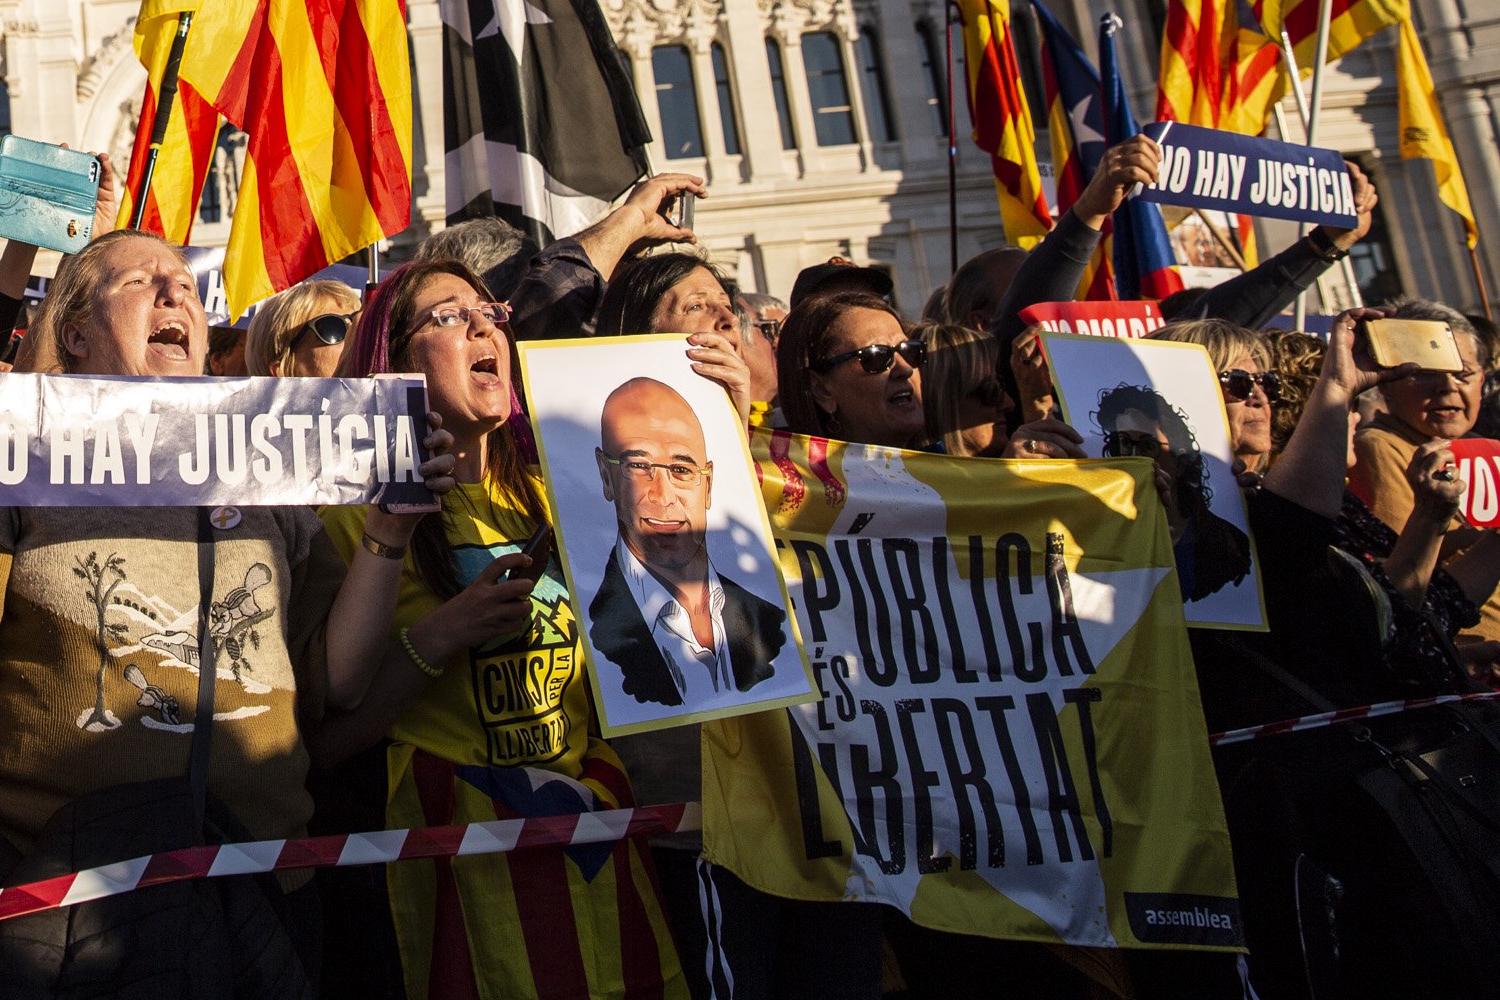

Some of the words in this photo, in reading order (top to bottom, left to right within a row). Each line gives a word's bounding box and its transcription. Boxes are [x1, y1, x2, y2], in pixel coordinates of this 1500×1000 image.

[1149, 144, 1192, 194] NO
[1192, 149, 1247, 201] HAY
[1250, 156, 1357, 217] JUSTÍCIA
[50, 411, 160, 485] HAY
[178, 396, 425, 485] JUSTÍCIA
[775, 512, 1097, 687] PÚBLICA
[483, 656, 545, 715] CIMS
[550, 676, 566, 701] PER
[555, 654, 571, 671] LA
[812, 646, 857, 731] ÉS
[494, 714, 565, 760] LLIBERTAT
[1144, 906, 1232, 930] assemblea
